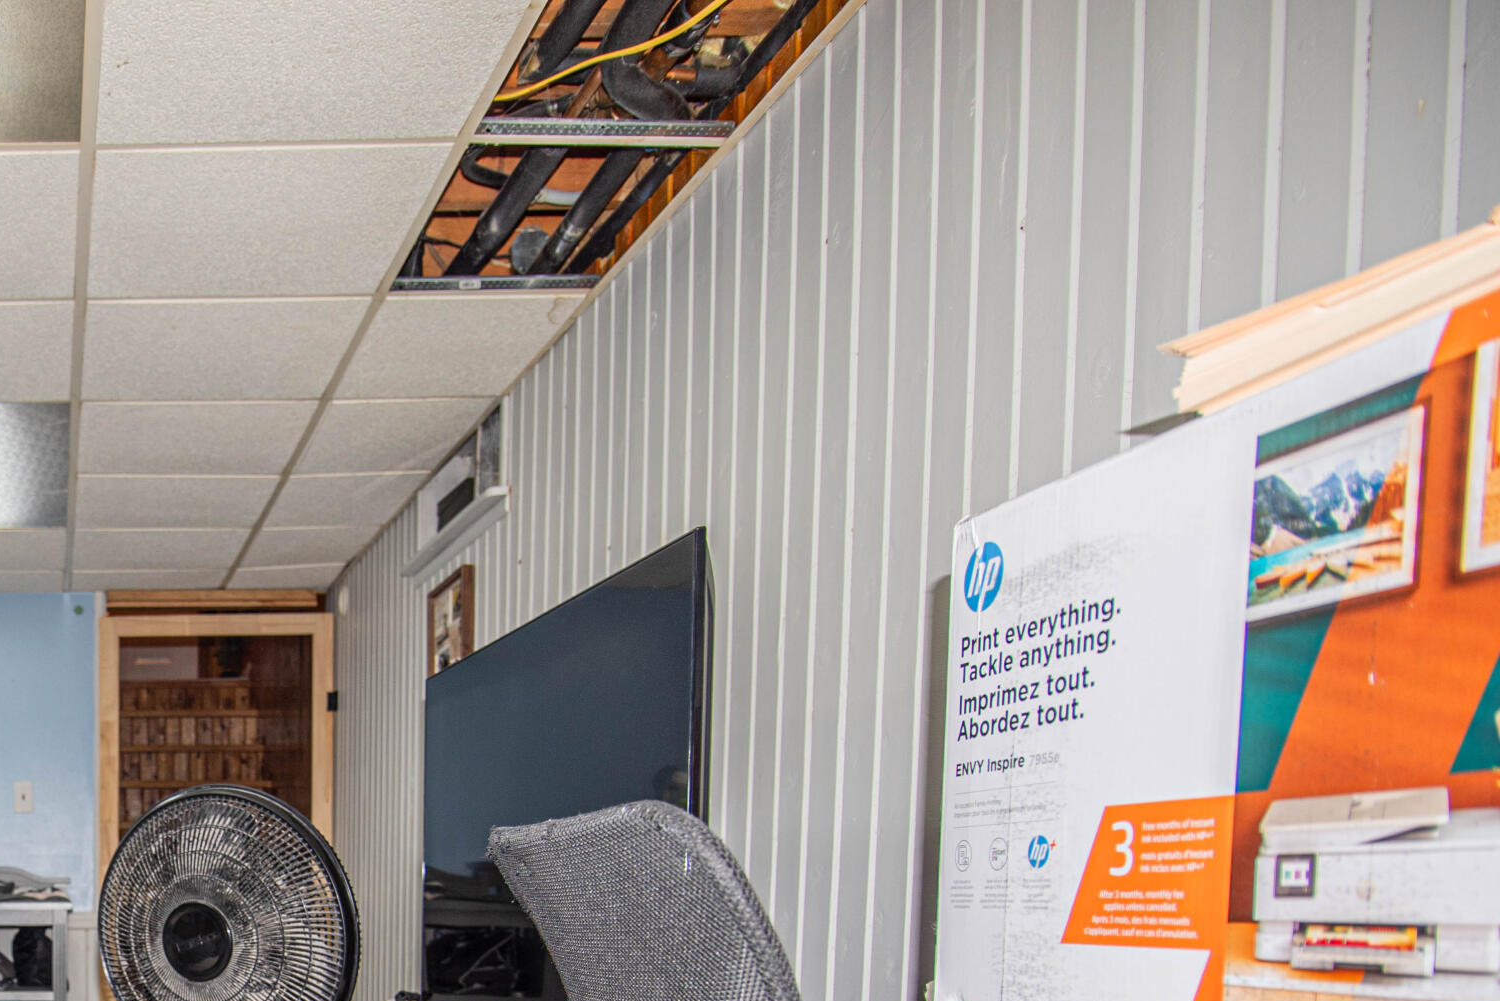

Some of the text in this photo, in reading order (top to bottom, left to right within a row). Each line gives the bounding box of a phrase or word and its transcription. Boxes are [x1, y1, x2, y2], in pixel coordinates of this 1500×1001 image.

[965, 542, 1003, 612] hp
[960, 597, 1122, 658] Print everything.
[960, 628, 1117, 684] Tackle anything.
[958, 666, 1096, 716] Imprimez tout.
[956, 698, 1085, 743] Abordez tout.
[955, 759, 985, 778] ENVY
[986, 752, 1026, 774] Inspire
[1109, 820, 1135, 877] 3
